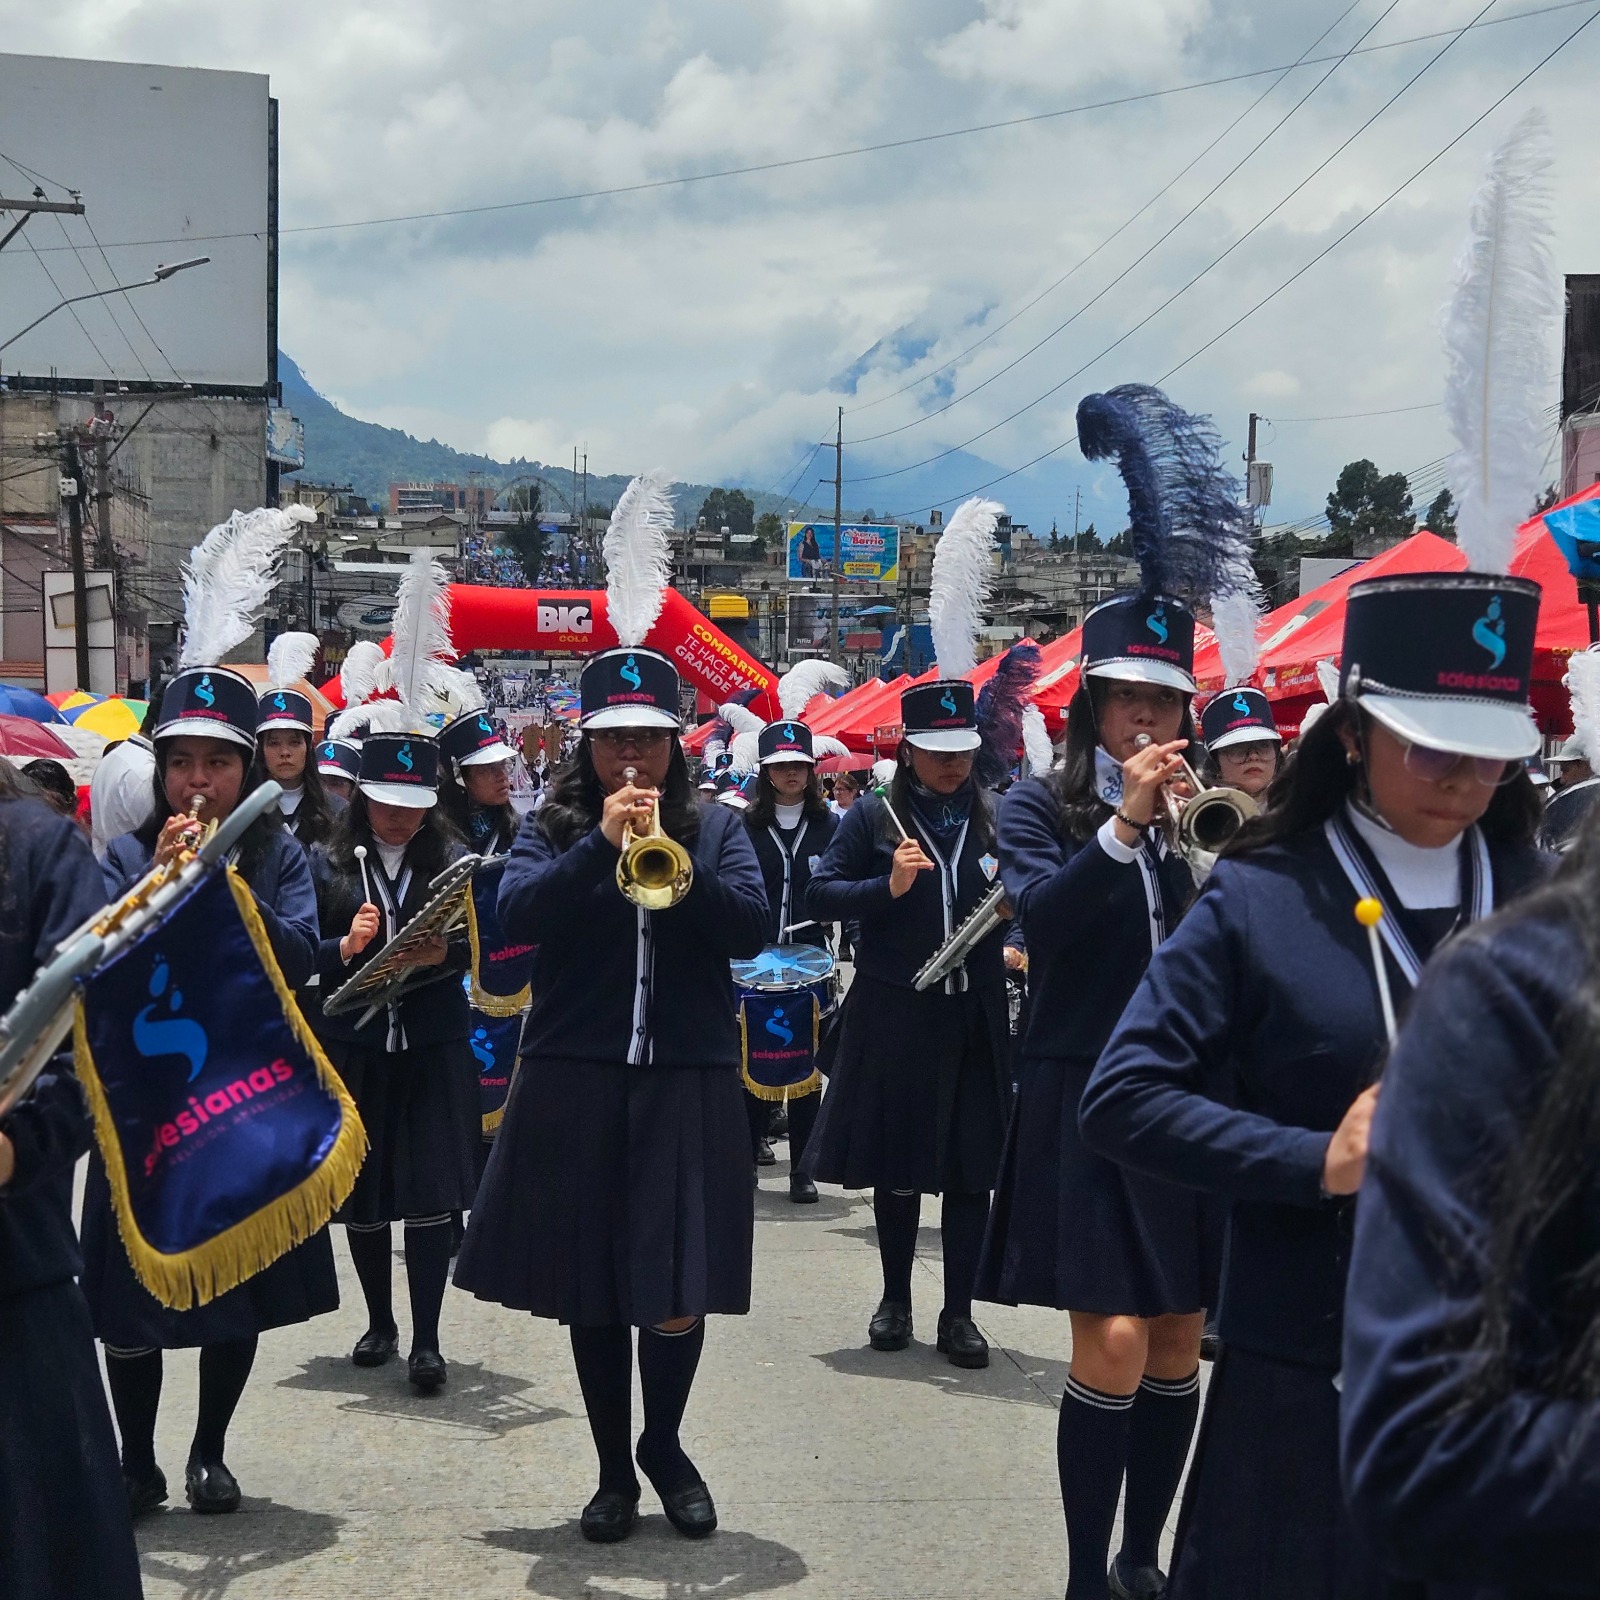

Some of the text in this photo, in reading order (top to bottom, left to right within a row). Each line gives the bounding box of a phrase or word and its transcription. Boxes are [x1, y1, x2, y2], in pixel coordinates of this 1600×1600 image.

[852, 537, 884, 545] Barrio
[537, 606, 593, 633] BIG
[559, 635, 589, 643] COLA
[693, 624, 769, 689] COMPARTIR
[675, 645, 732, 694] GRANDE
[684, 633, 757, 692] TE HACE MÁ
